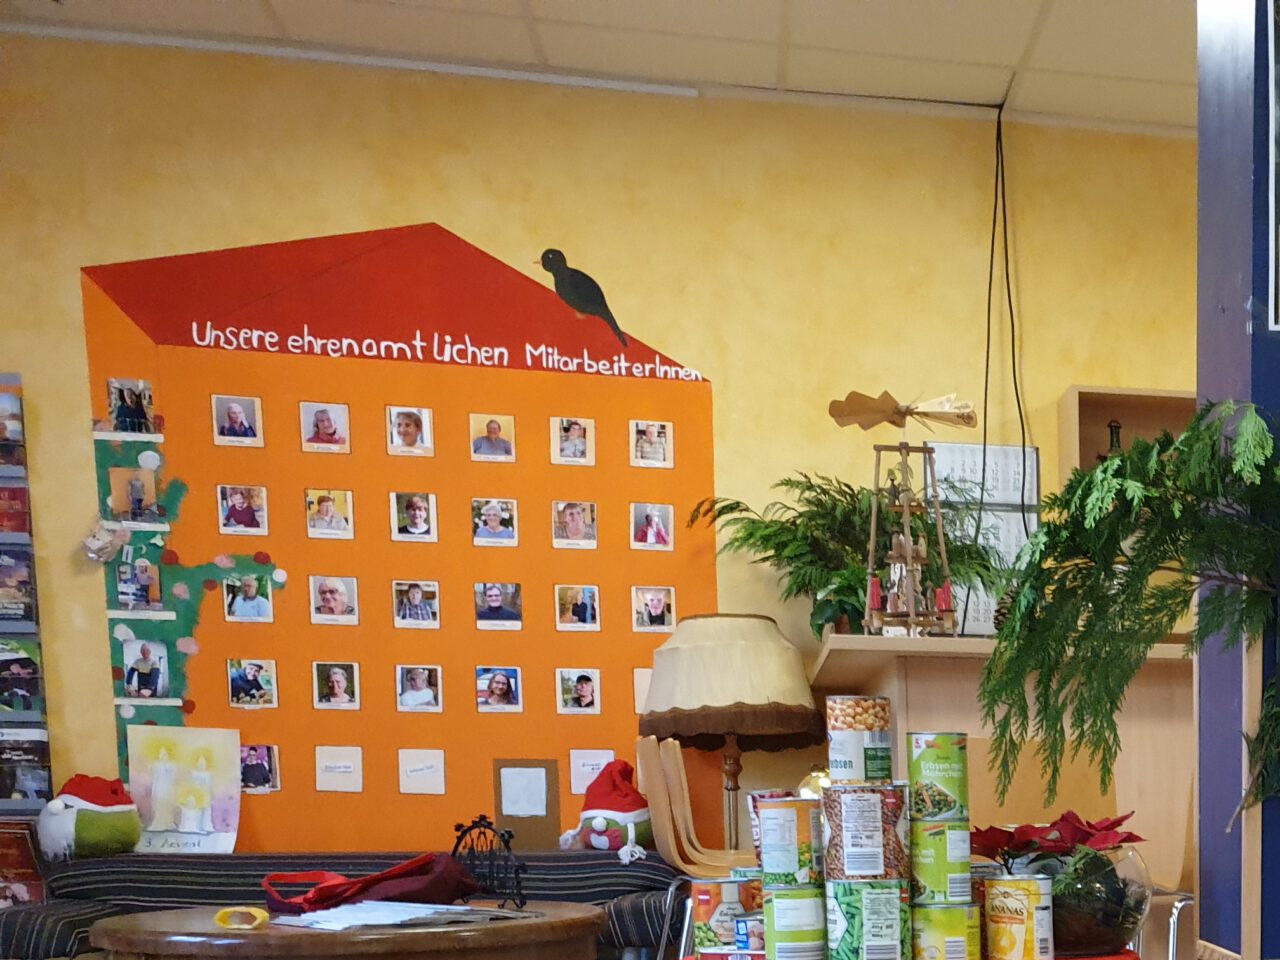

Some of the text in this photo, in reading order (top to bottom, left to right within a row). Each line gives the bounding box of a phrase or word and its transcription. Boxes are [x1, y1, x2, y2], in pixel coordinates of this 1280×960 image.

[191, 321, 279, 352] Unsere
[525, 342, 703, 382] MitarbeiterInnen
[991, 904, 1024, 916] ANANAS
